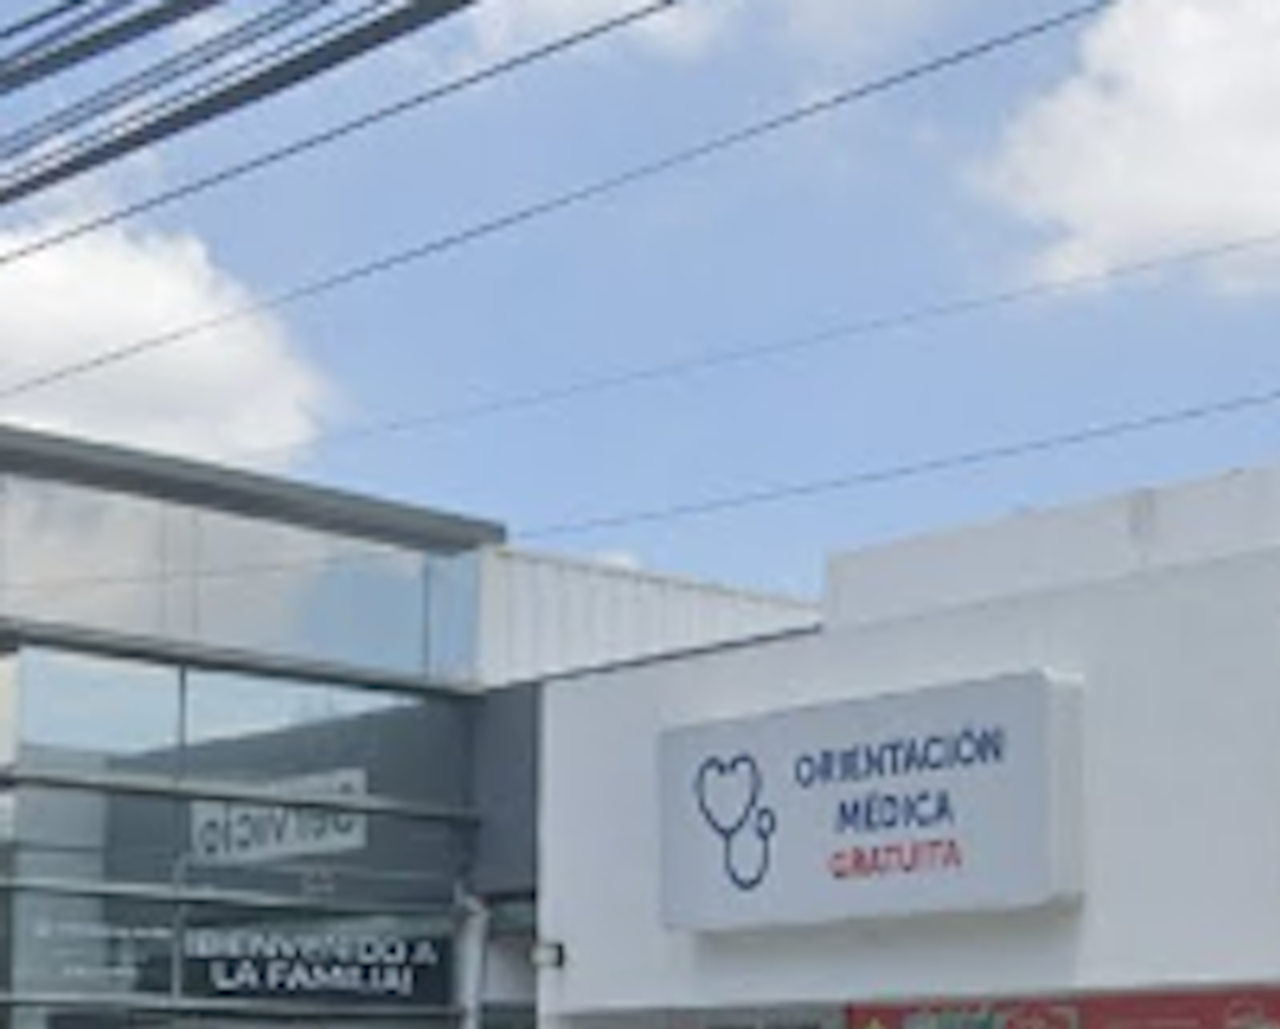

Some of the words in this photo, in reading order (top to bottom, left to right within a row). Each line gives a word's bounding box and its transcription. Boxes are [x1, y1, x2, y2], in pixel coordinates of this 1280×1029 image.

[795, 726, 1006, 788] ORIENTACIÓN
[835, 789, 955, 833] MÉDICA
[829, 839, 963, 879] GRATUITA
[209, 958, 258, 990] LA
